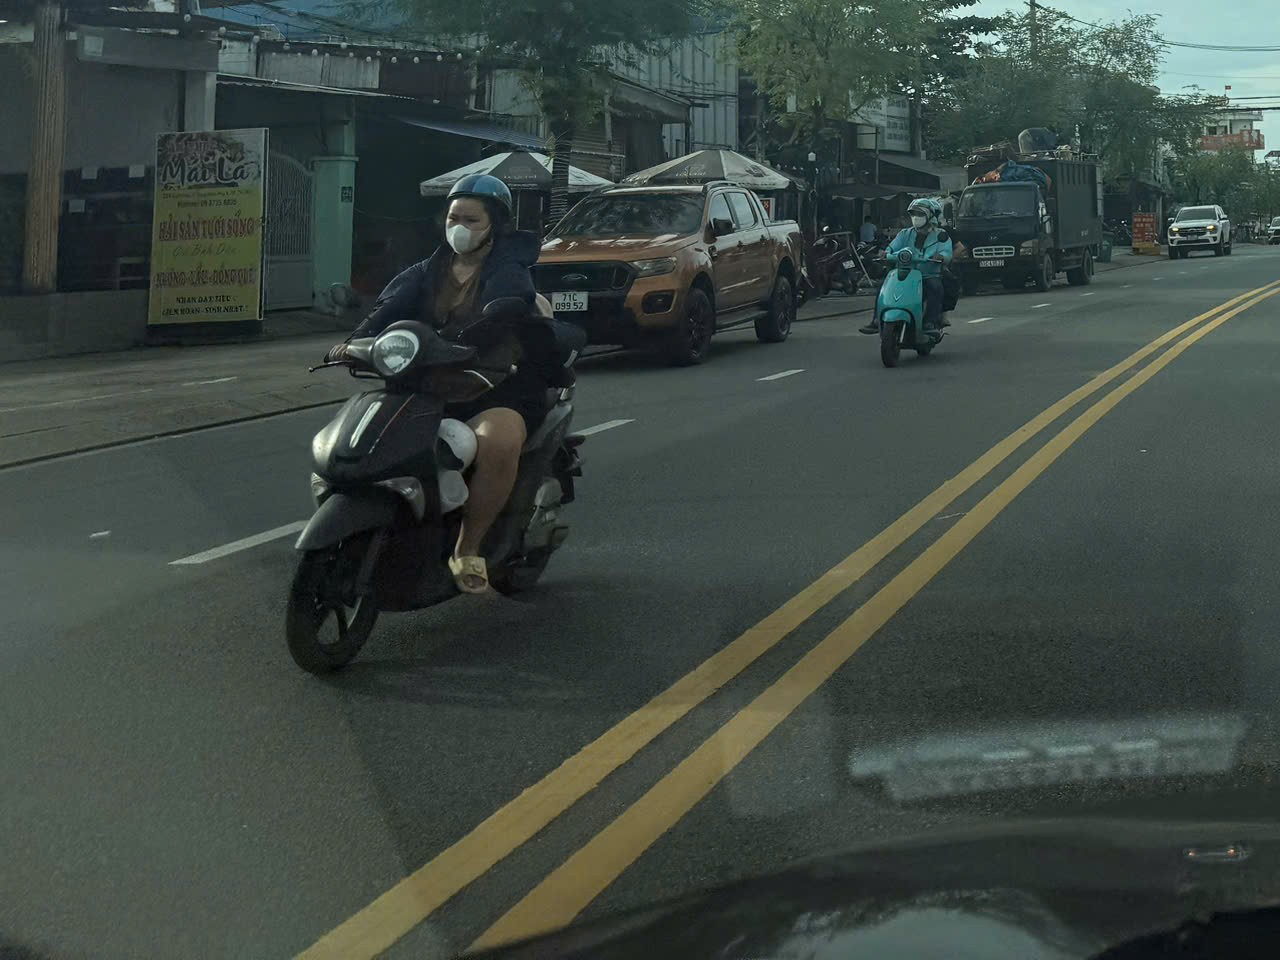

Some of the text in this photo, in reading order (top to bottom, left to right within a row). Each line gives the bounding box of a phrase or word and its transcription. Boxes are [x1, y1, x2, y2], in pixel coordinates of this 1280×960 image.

[162, 157, 211, 186] Mái
[159, 213, 178, 241] HẢI
[178, 213, 200, 240] SẢN
[562, 293, 577, 301] 71C
